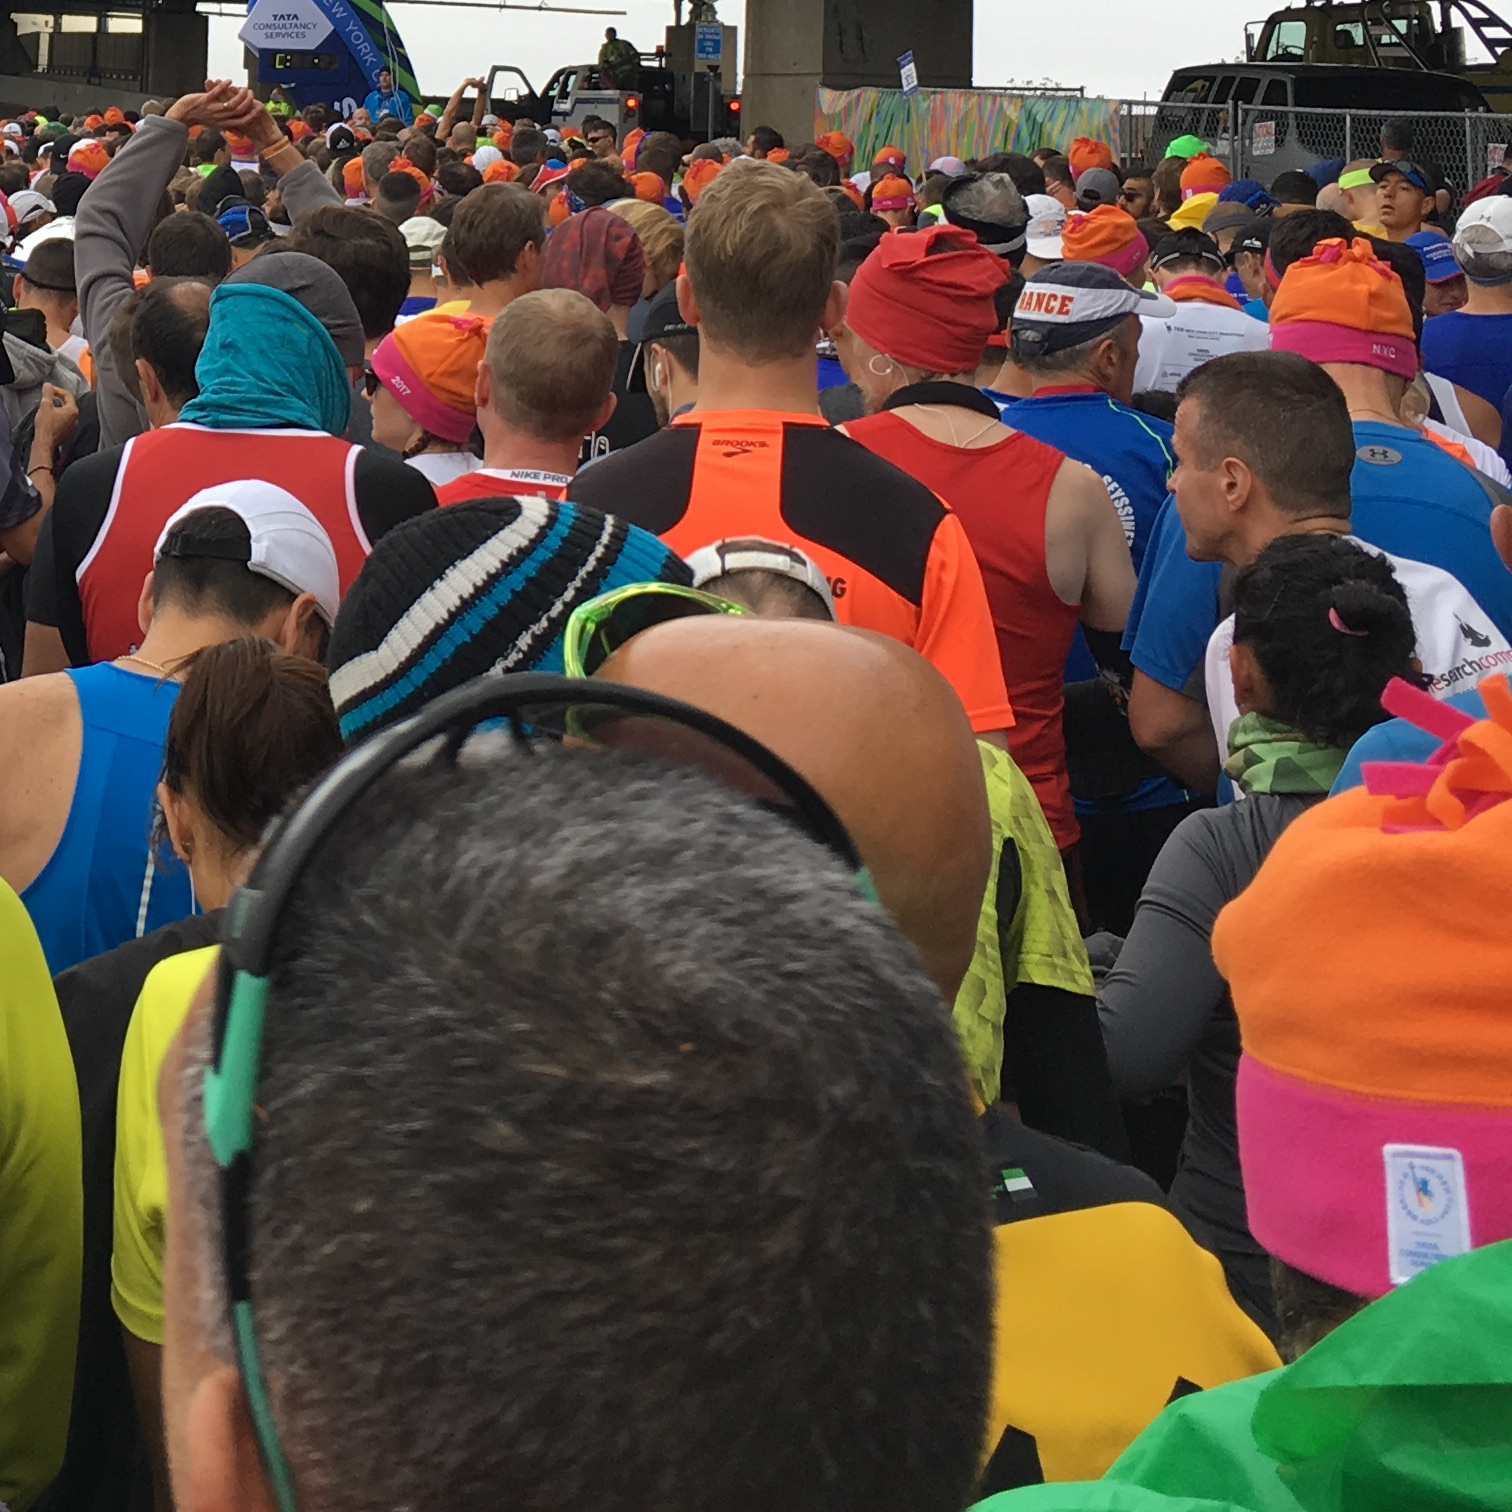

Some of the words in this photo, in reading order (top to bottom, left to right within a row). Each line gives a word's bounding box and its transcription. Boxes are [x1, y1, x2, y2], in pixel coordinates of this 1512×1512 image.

[272, 13, 300, 21] TATA
[252, 22, 318, 31] CONSULTANCY
[264, 31, 307, 40] SERVICES
[346, 19, 378, 67] YORK
[1372, 343, 1397, 359] NYC
[390, 375, 412, 396] 2017
[711, 439, 769, 449] BROOKS
[509, 470, 542, 481] NIKE
[543, 473, 569, 484] PRO
